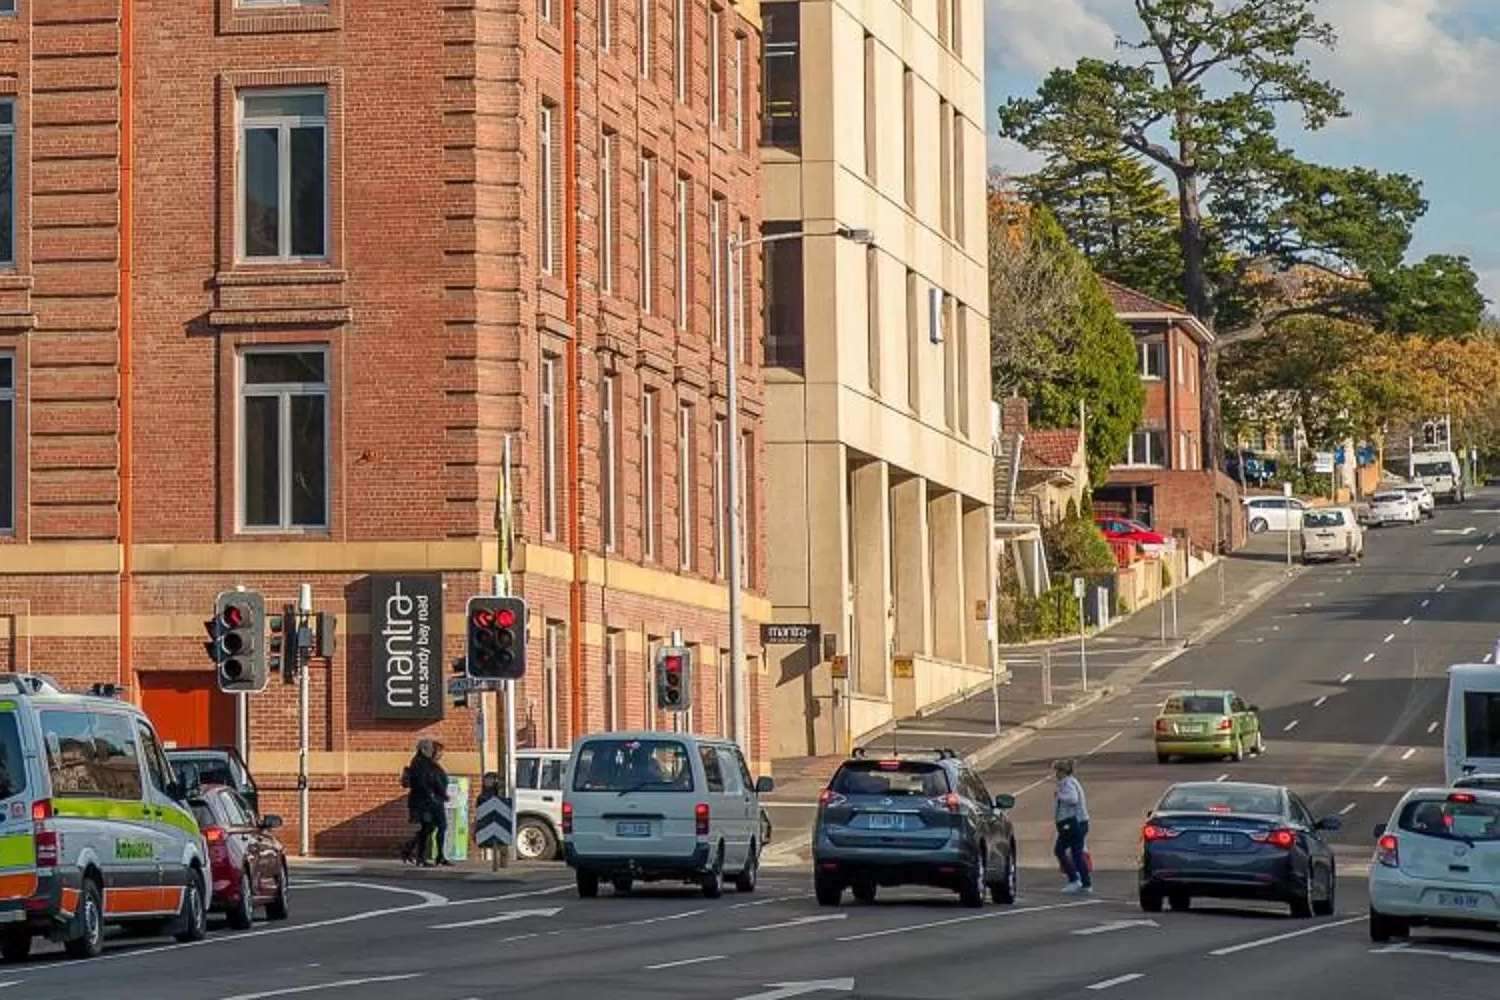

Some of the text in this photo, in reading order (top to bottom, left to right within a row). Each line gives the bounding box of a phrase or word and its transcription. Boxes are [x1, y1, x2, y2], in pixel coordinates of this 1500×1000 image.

[382, 581, 414, 708] mantra
[415, 595, 431, 707] one sandy bay road
